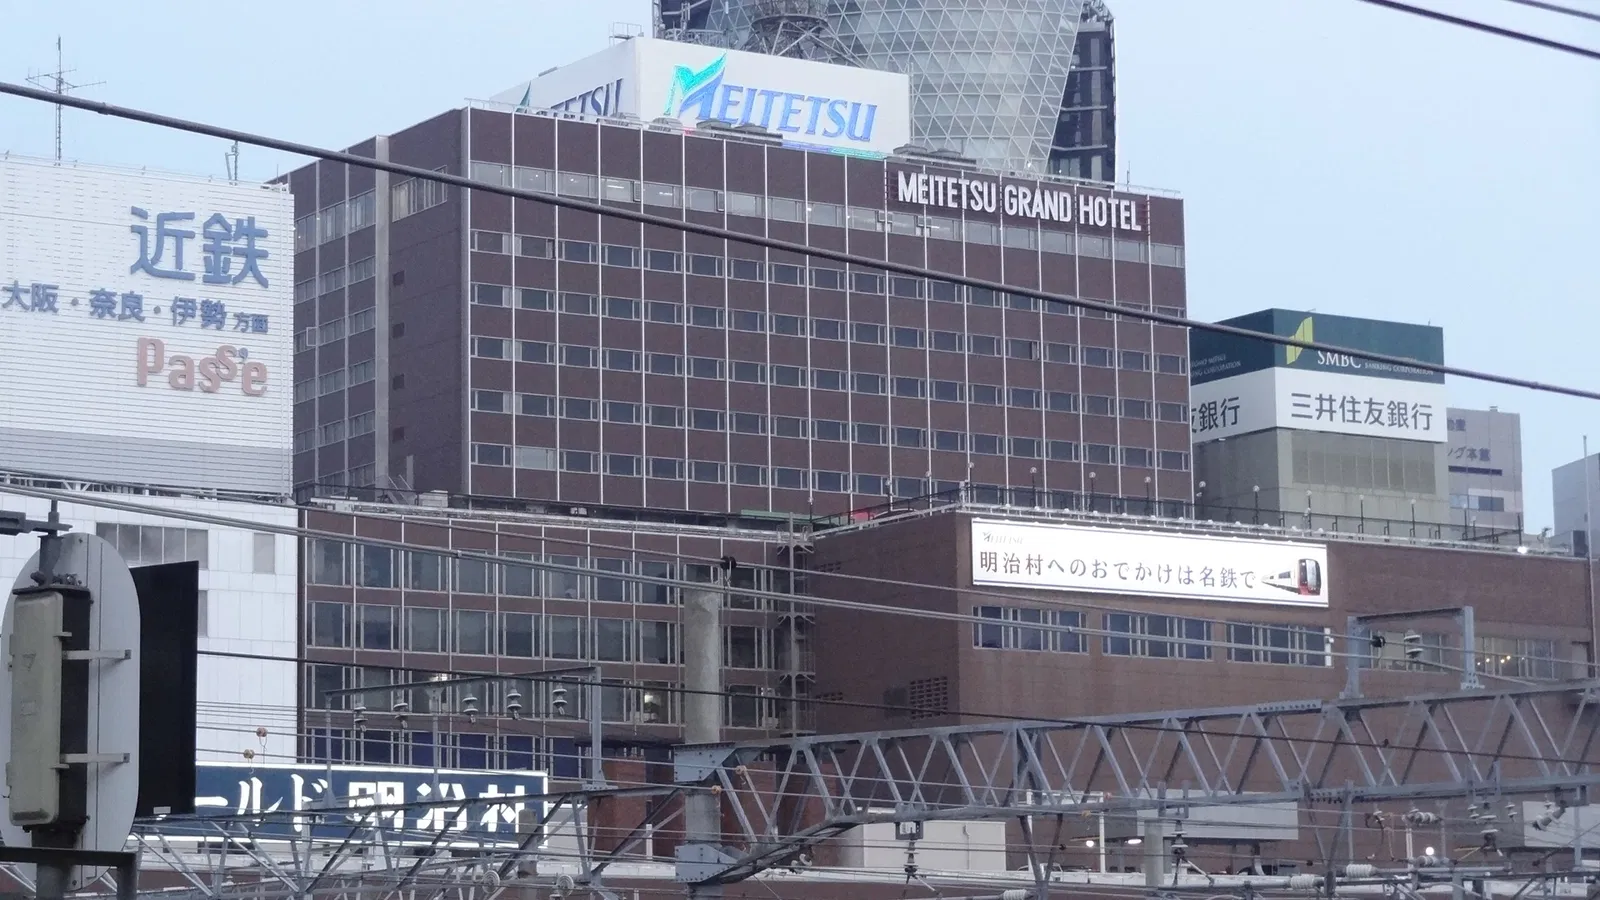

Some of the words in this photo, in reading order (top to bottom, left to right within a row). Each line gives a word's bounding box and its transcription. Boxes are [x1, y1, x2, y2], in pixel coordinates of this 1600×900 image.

[663, 50, 877, 142] MEITETSU
[898, 170, 997, 213] MEITETSU
[1004, 184, 1072, 223] GRAND
[1079, 194, 1142, 231] HOTEL
[130, 205, 269, 289] 近鉄
[1317, 350, 1362, 369] SMBC
[1291, 392, 1433, 431] 三井住友銀行
[980, 551, 1256, 589] 明治村へのおでかけは名鉄で
[157, 774, 330, 832] ールド
